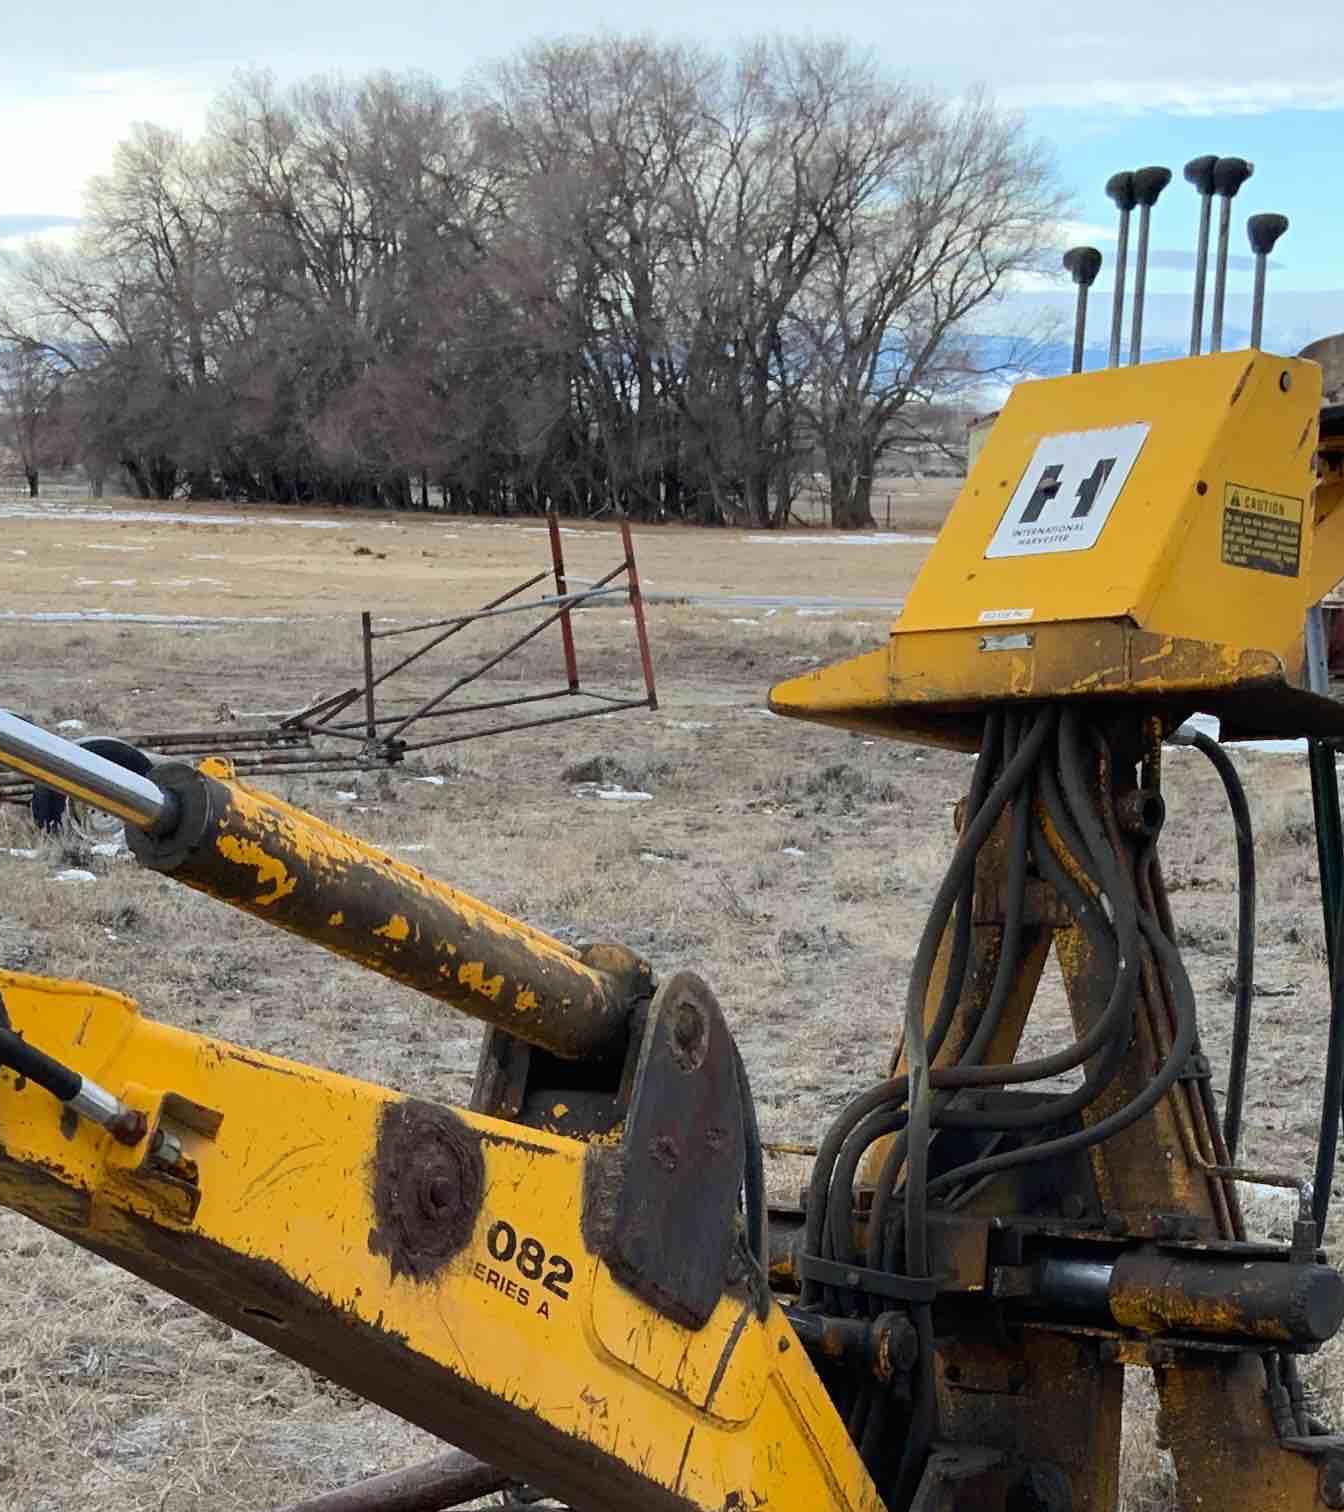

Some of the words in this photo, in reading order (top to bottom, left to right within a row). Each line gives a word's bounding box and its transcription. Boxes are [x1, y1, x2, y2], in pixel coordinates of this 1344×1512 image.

[1245, 496, 1284, 515] CAUTION
[1013, 522, 1084, 537] INTERNATIONAL
[1018, 535, 1069, 546] HARVESTER
[536, 1301, 550, 1320] A
